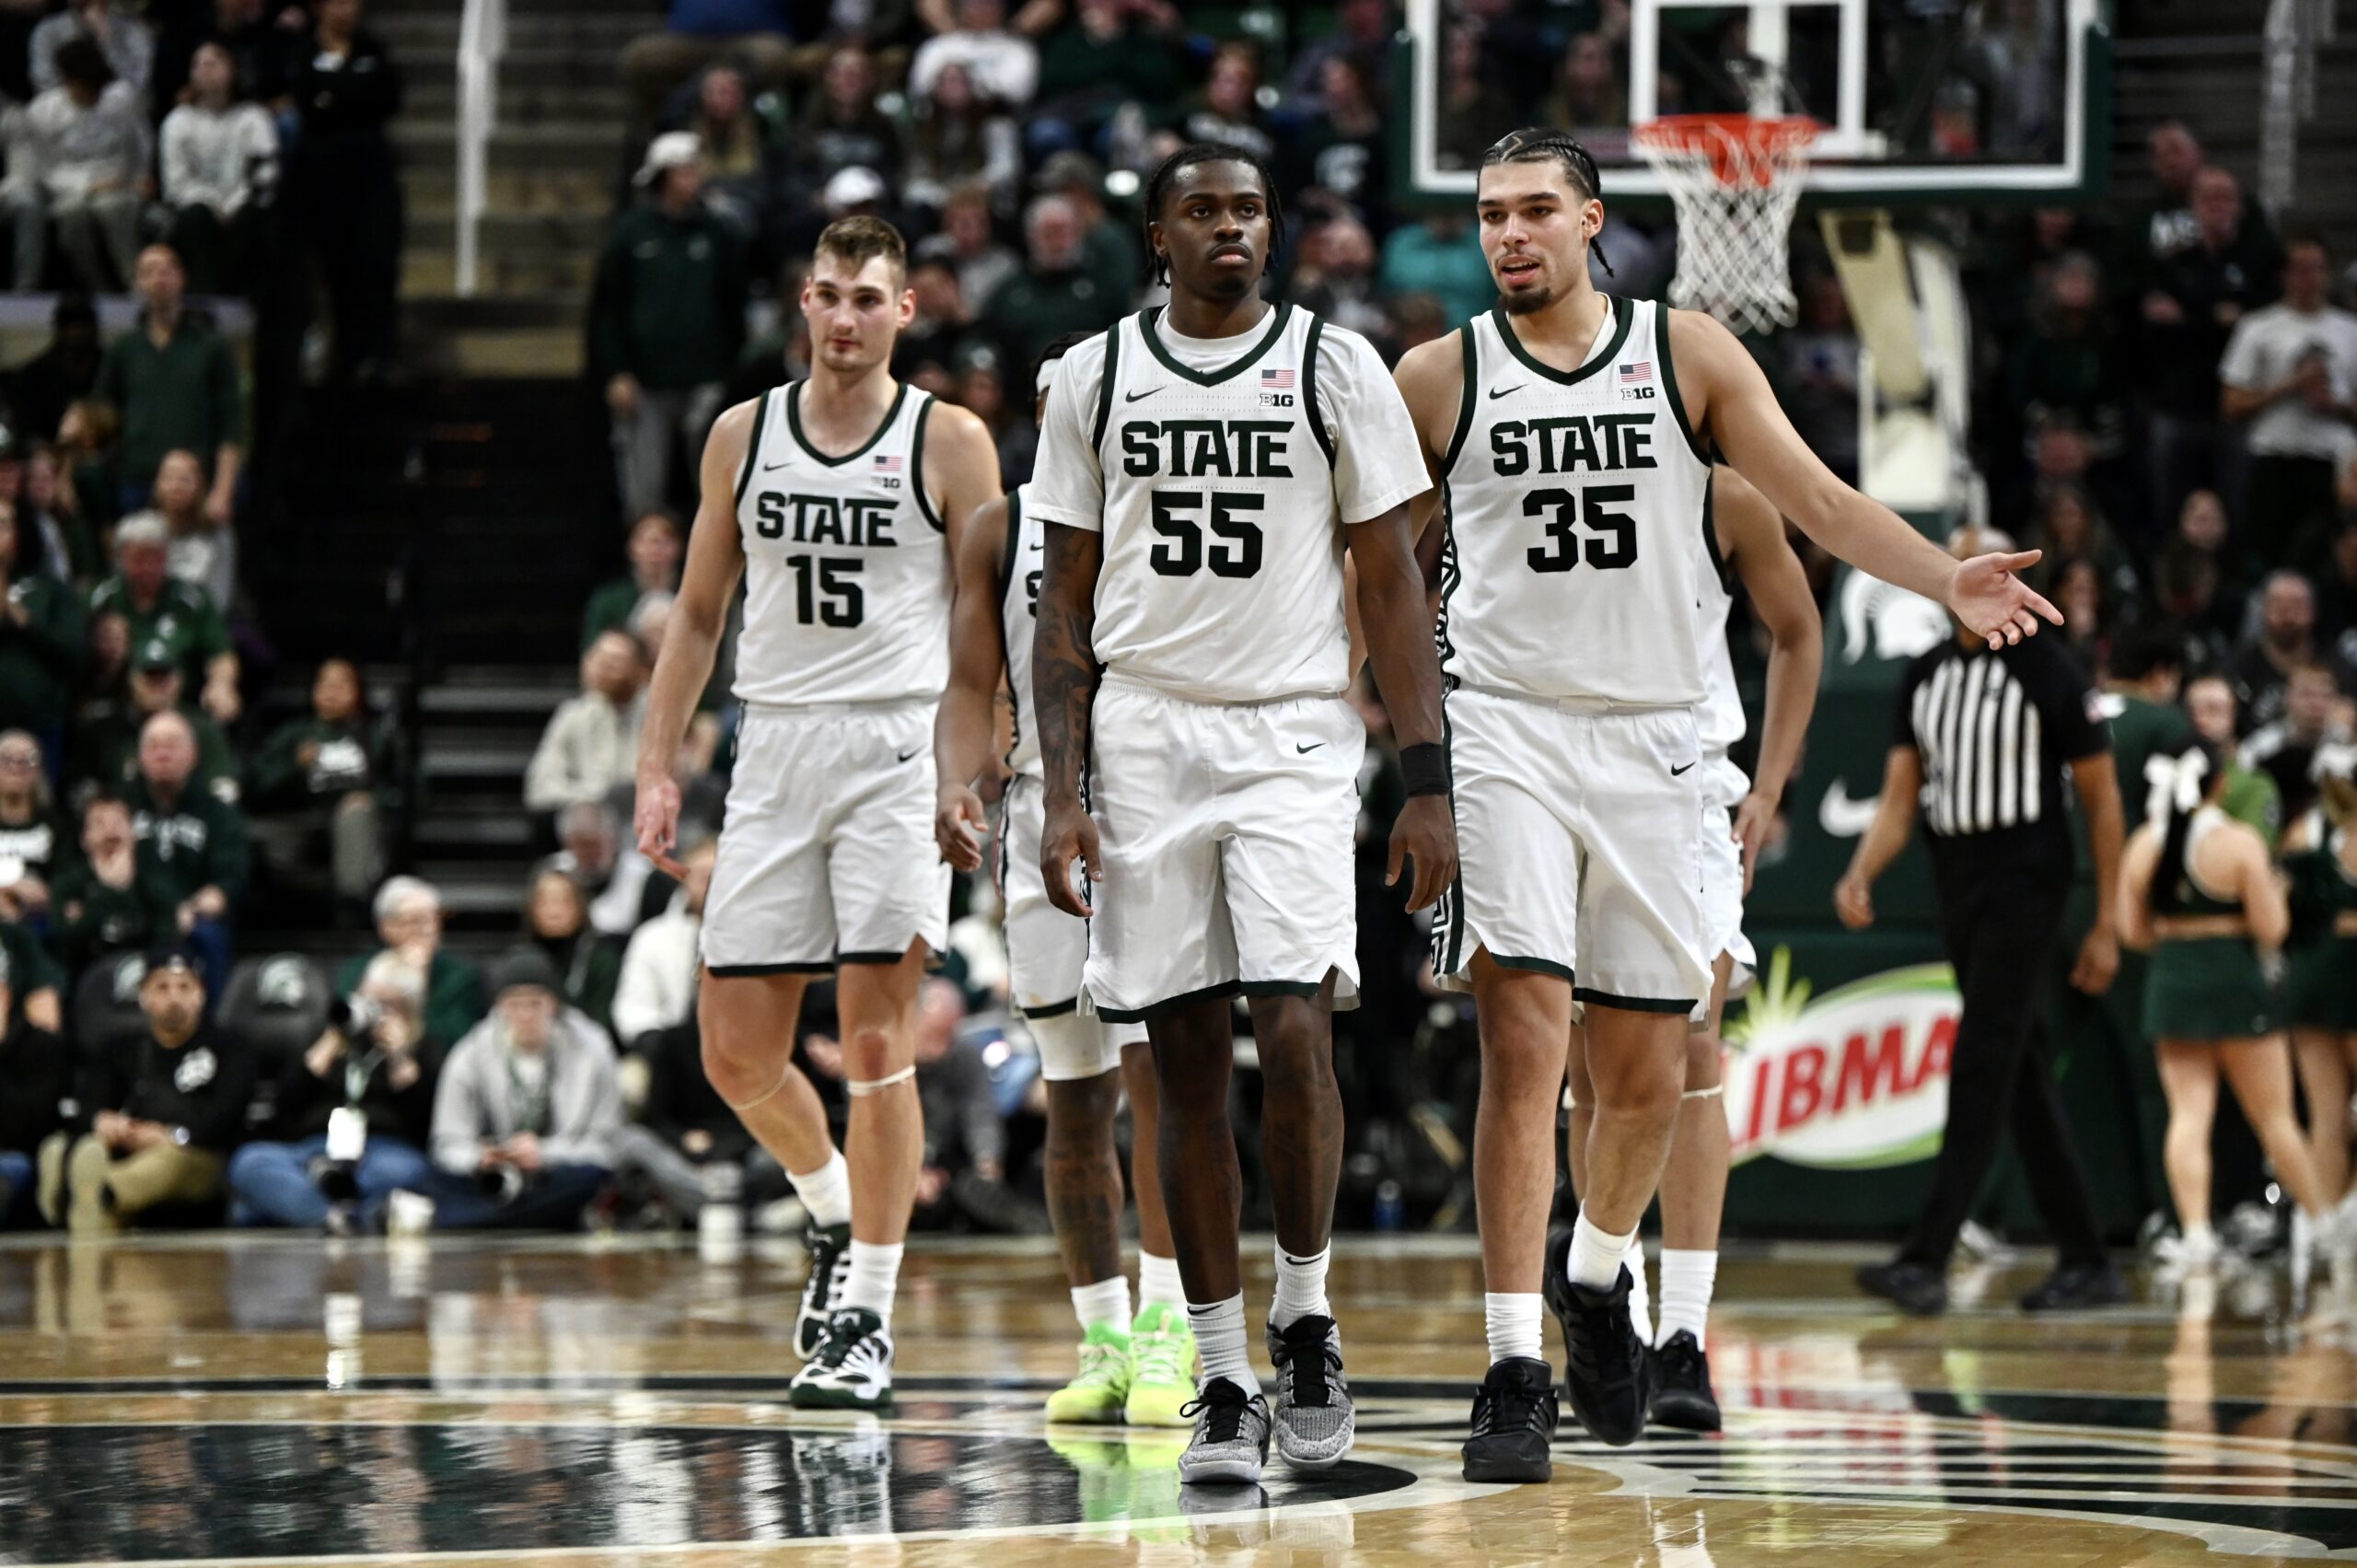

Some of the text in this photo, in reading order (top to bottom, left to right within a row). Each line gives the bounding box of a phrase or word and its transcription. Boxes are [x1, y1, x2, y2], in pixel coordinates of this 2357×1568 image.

[1259, 393, 1294, 407] B1G
[1121, 420, 1295, 478] STATE
[1490, 413, 1658, 477] STATE
[757, 491, 900, 547] STATE
[1150, 490, 1265, 578] 55
[1522, 484, 1638, 573] 35
[786, 554, 864, 628] 15
[1722, 1015, 1960, 1149] IBMA
